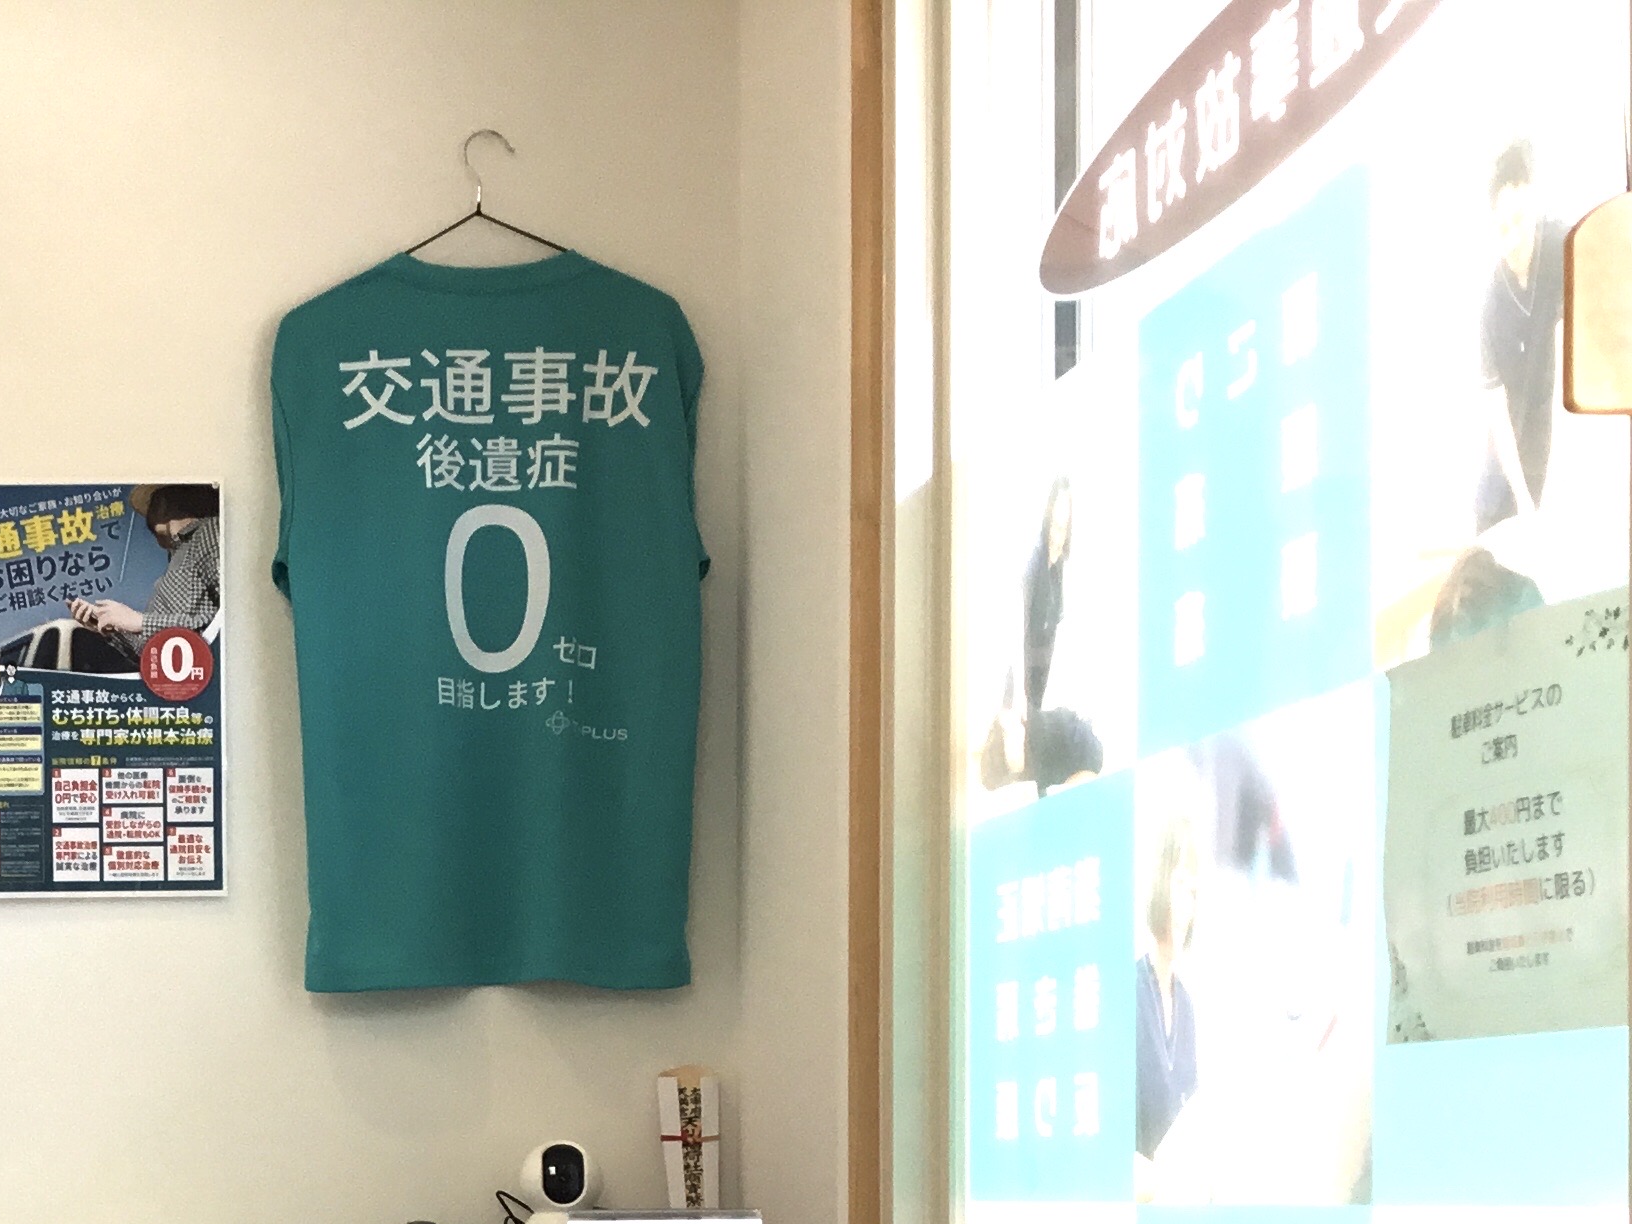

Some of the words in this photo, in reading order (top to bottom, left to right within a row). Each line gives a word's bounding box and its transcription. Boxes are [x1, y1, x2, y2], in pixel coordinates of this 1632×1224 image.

[339, 347, 658, 430] 交通事故
[416, 433, 580, 491] 後遺症
[95, 500, 125, 520] 治療
[445, 504, 551, 673] 0
[160, 637, 204, 682] 0円
[553, 636, 597, 670] ゼロ
[52, 728, 214, 746] 治療を専門家が根本治療
[572, 720, 628, 741] PLUS
